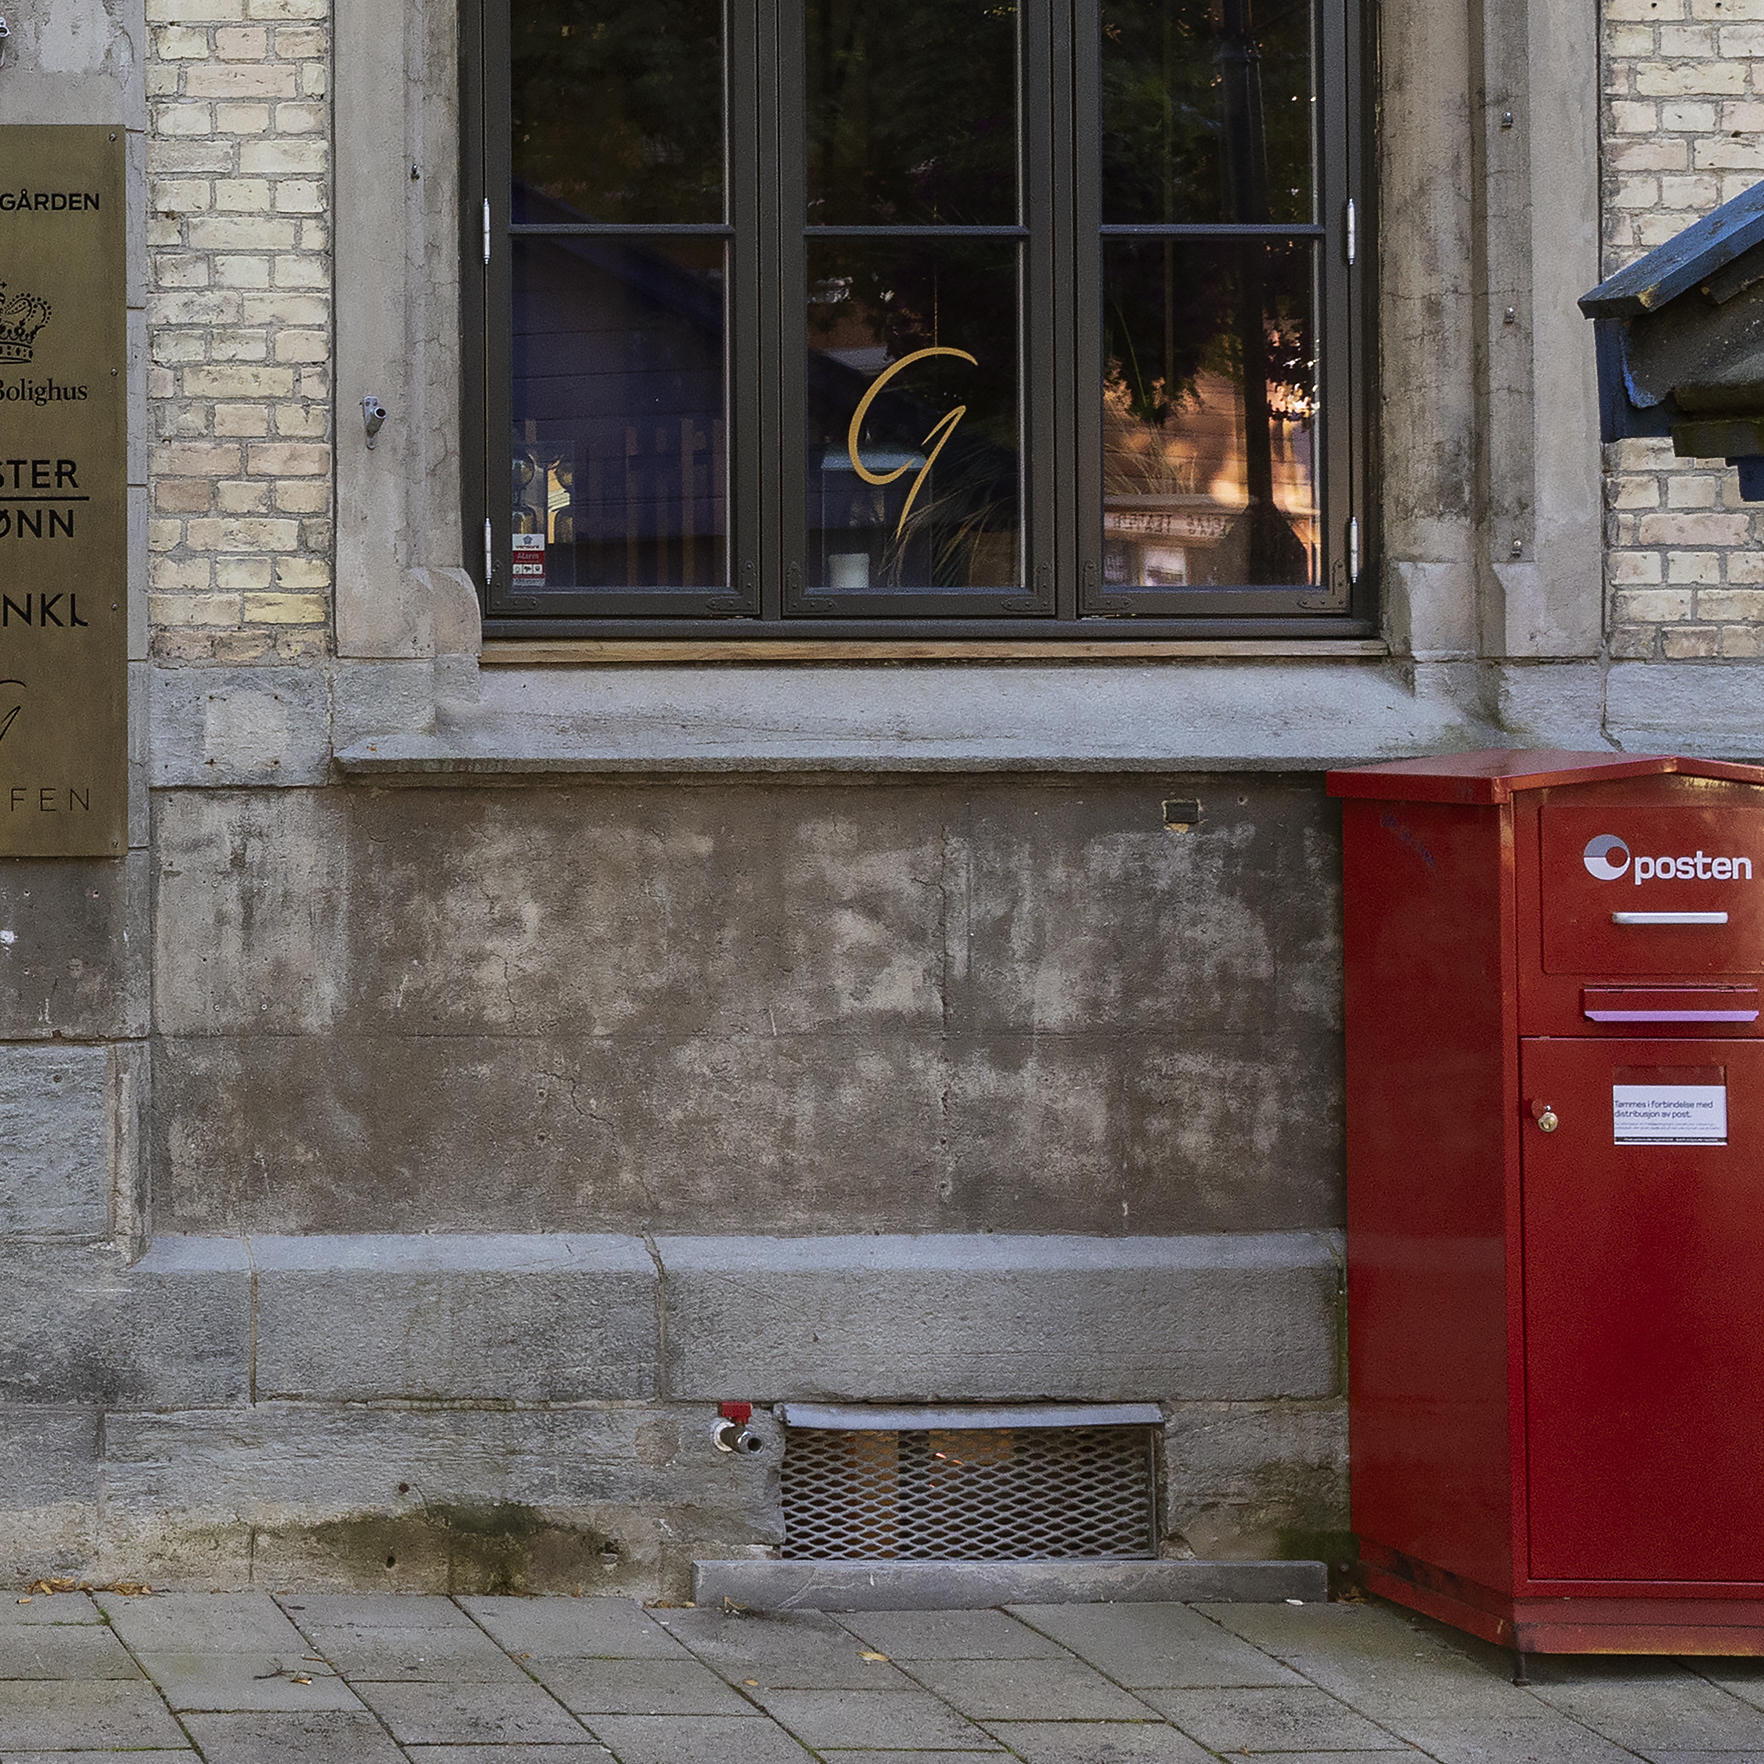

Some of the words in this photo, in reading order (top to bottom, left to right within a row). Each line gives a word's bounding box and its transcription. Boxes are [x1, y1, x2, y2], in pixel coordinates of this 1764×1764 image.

[1634, 850, 1753, 886] posten
[1651, 1100, 1695, 1109] forbindelse
[1696, 1100, 1713, 1109] med
[1614, 1110, 1660, 1120] distribusjon
